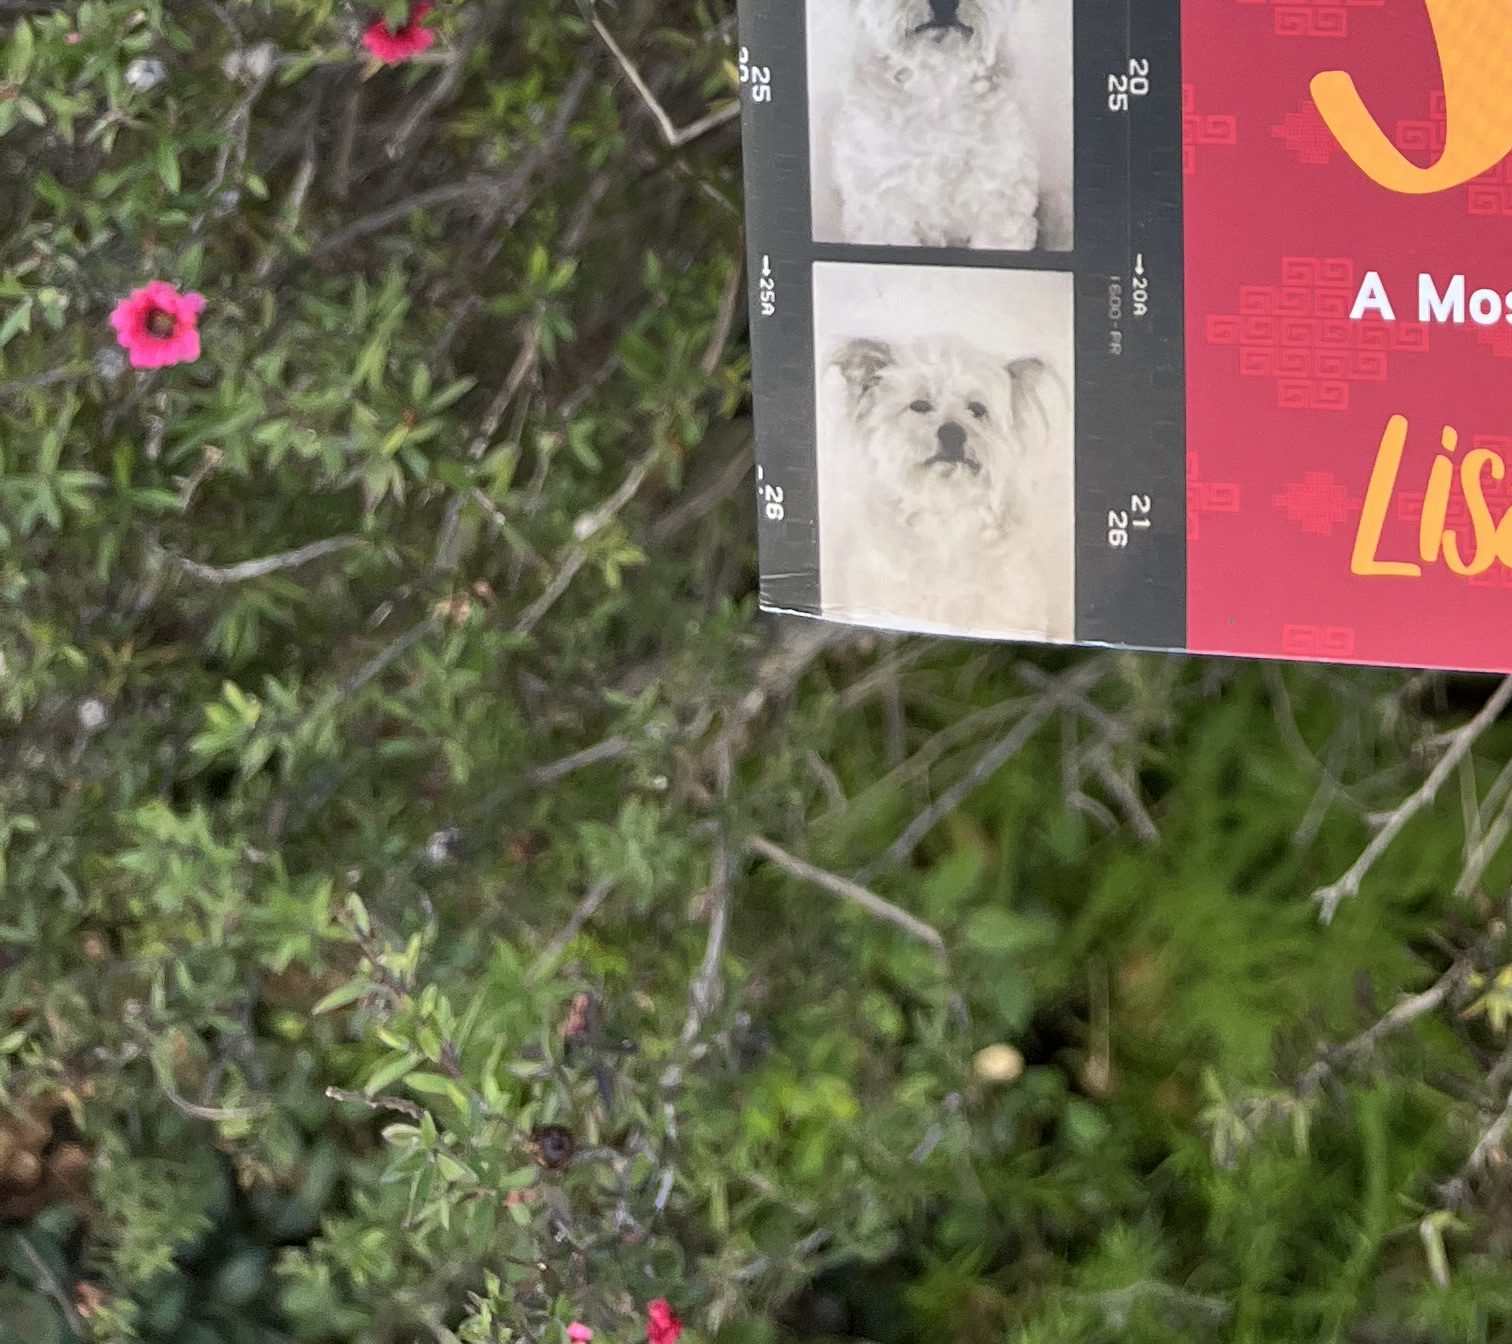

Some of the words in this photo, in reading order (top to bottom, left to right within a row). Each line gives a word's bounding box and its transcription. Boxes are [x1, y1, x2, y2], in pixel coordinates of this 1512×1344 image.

[750, 65, 772, 103] 25
[1107, 73, 1129, 111] 25
[1128, 58, 1150, 96] 20
[760, 277, 776, 316] 25A
[1132, 276, 1149, 316] 20A
[1348, 271, 1396, 321] A
[764, 484, 785, 521] 26
[1131, 494, 1152, 528] 21
[1108, 510, 1129, 548] 26
